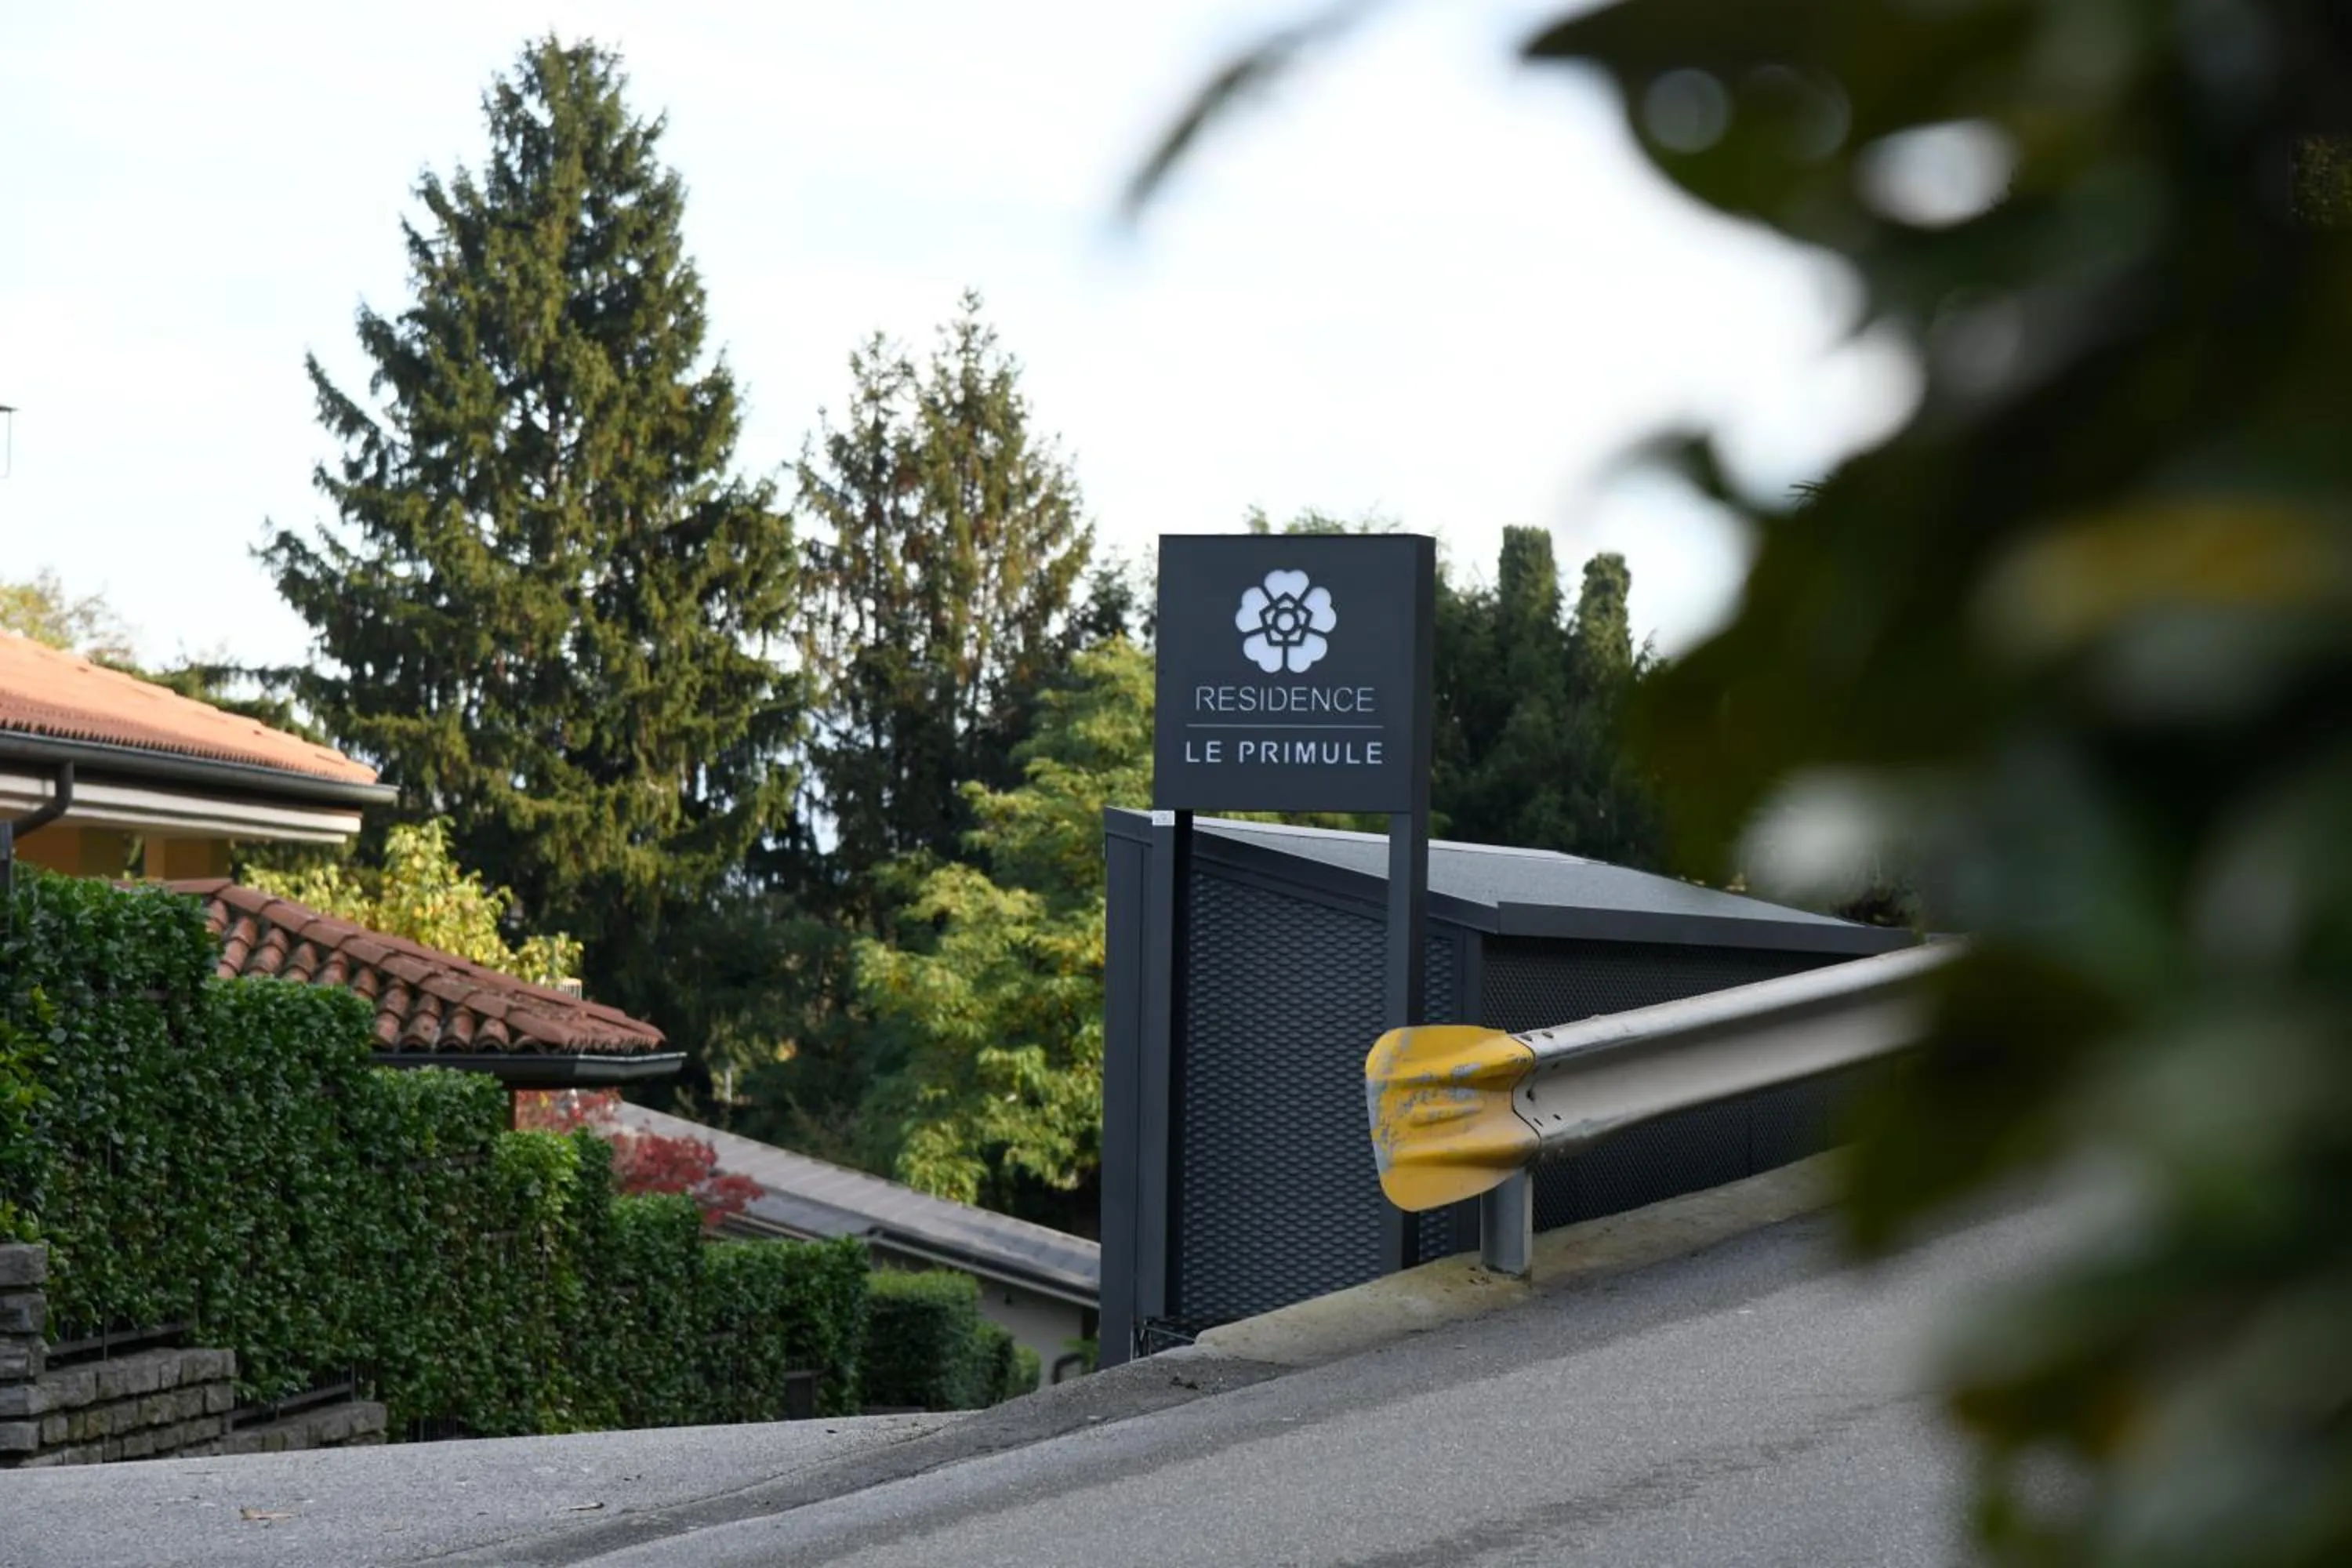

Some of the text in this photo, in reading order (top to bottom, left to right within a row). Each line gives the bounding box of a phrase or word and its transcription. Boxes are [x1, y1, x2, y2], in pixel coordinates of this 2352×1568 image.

[1195, 685, 1375, 712] RESIDENCE
[1185, 740, 1384, 765] LE PRIMULE
